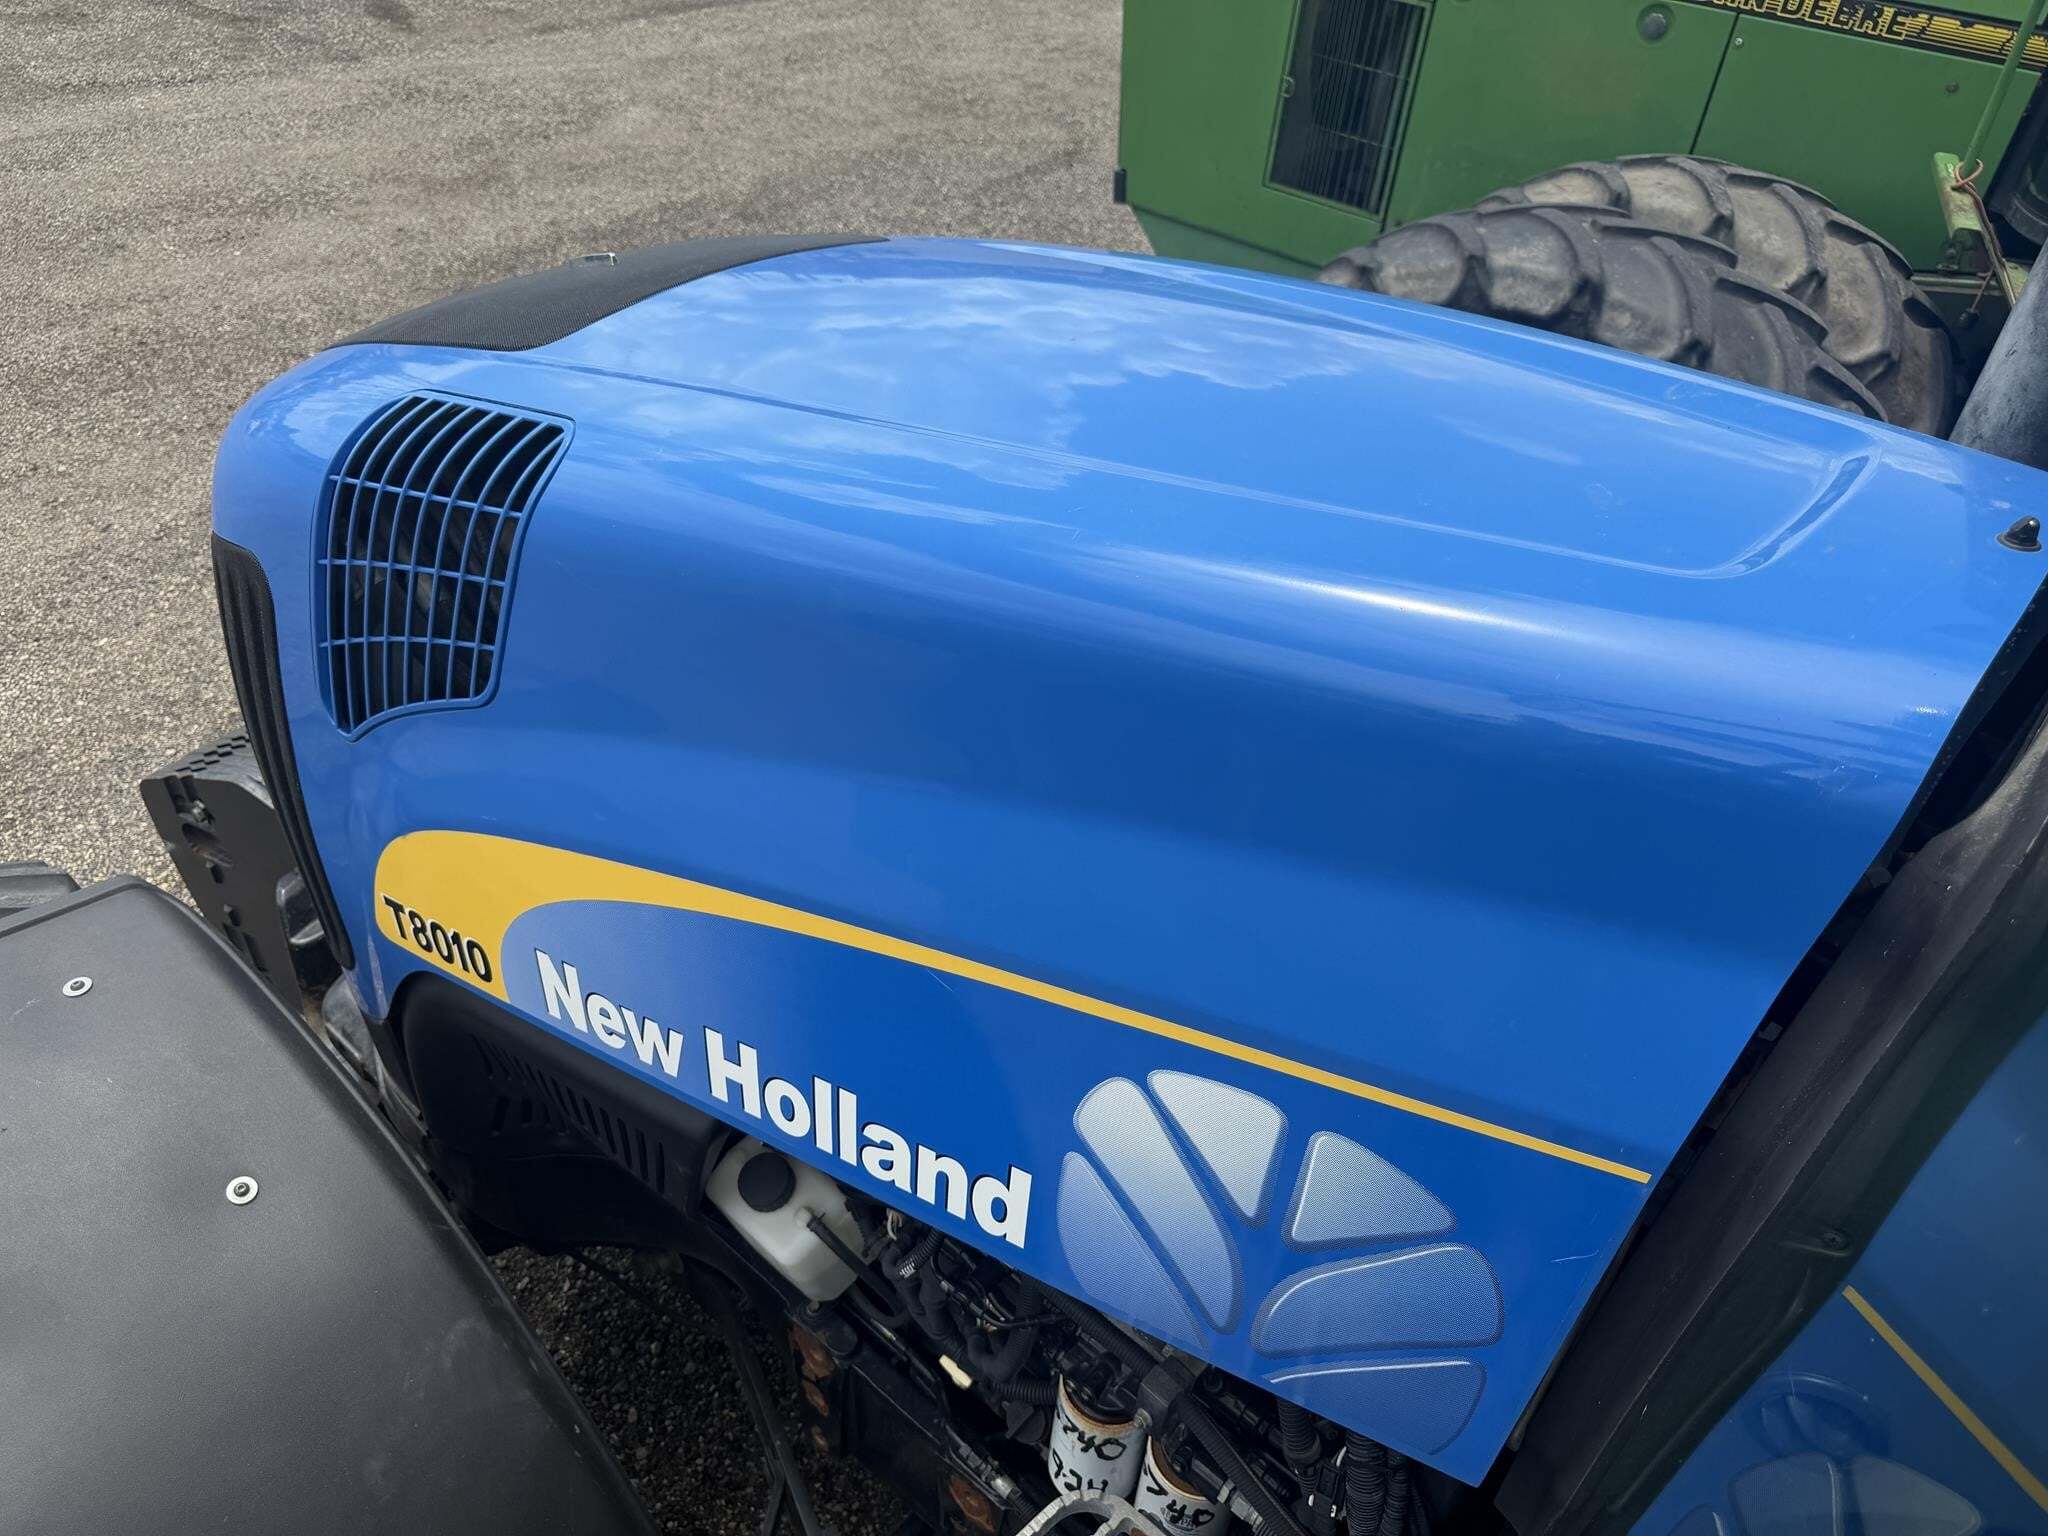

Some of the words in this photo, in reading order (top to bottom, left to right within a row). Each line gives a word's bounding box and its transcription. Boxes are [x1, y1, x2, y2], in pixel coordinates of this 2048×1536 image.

[383, 895, 492, 983] T8010
[534, 948, 684, 1078] New
[703, 1026, 1033, 1249] Holland
